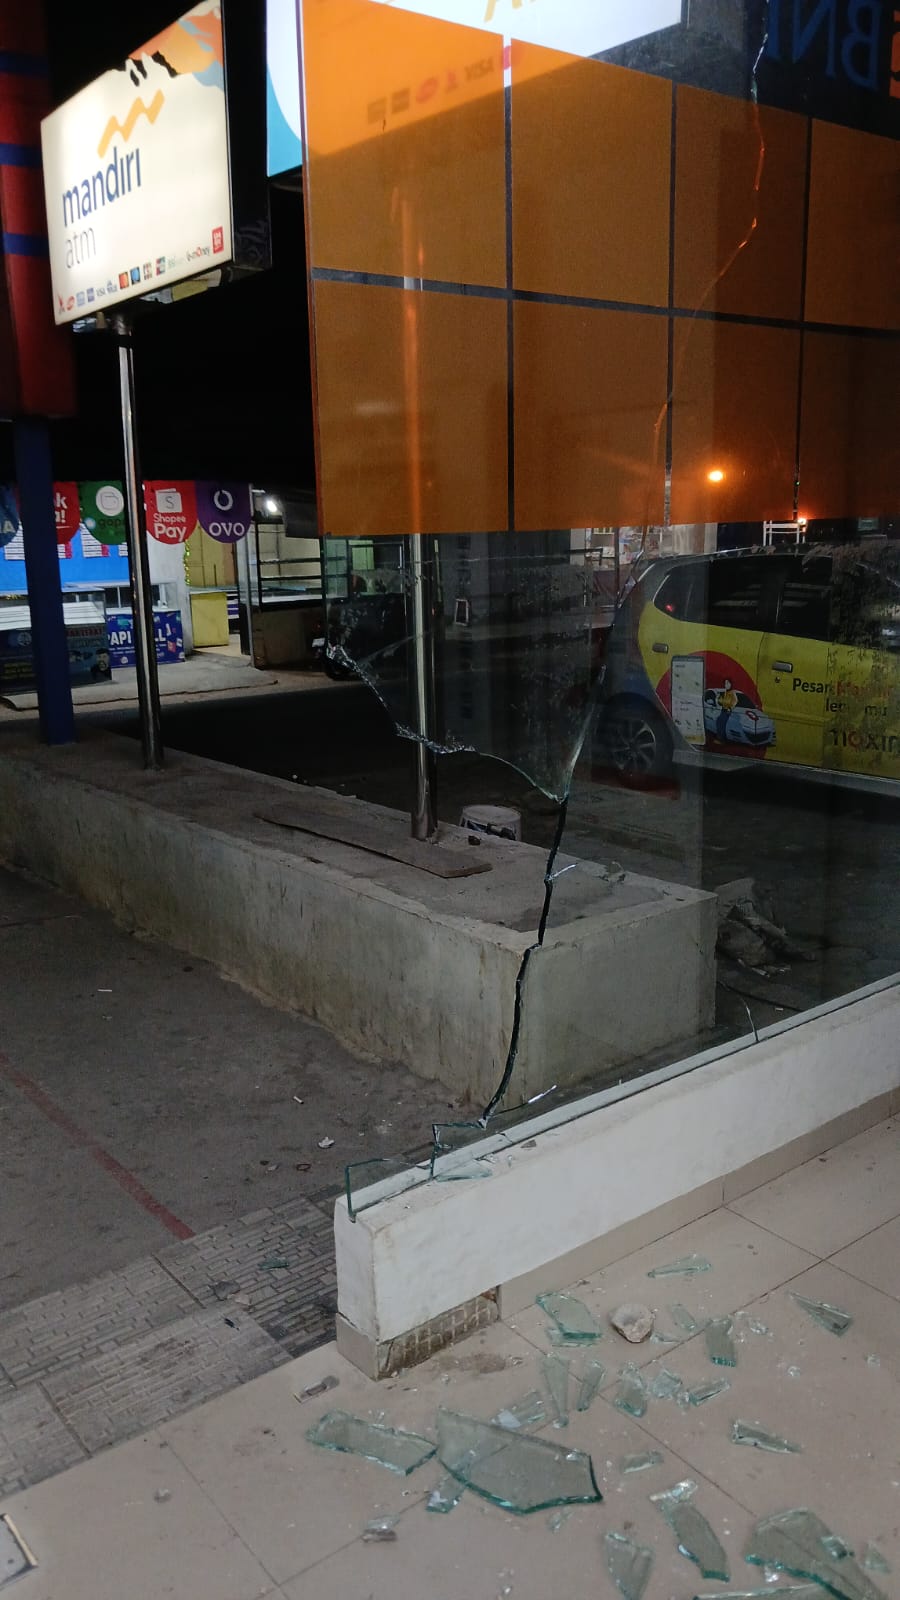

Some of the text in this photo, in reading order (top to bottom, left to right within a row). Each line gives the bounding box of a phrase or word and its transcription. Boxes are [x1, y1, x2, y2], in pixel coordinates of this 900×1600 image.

[62, 146, 142, 227] mandiri
[65, 227, 97, 269] atm
[153, 512, 186, 524] Shopee
[154, 523, 187, 542] Pay
[208, 522, 245, 537] OVO
